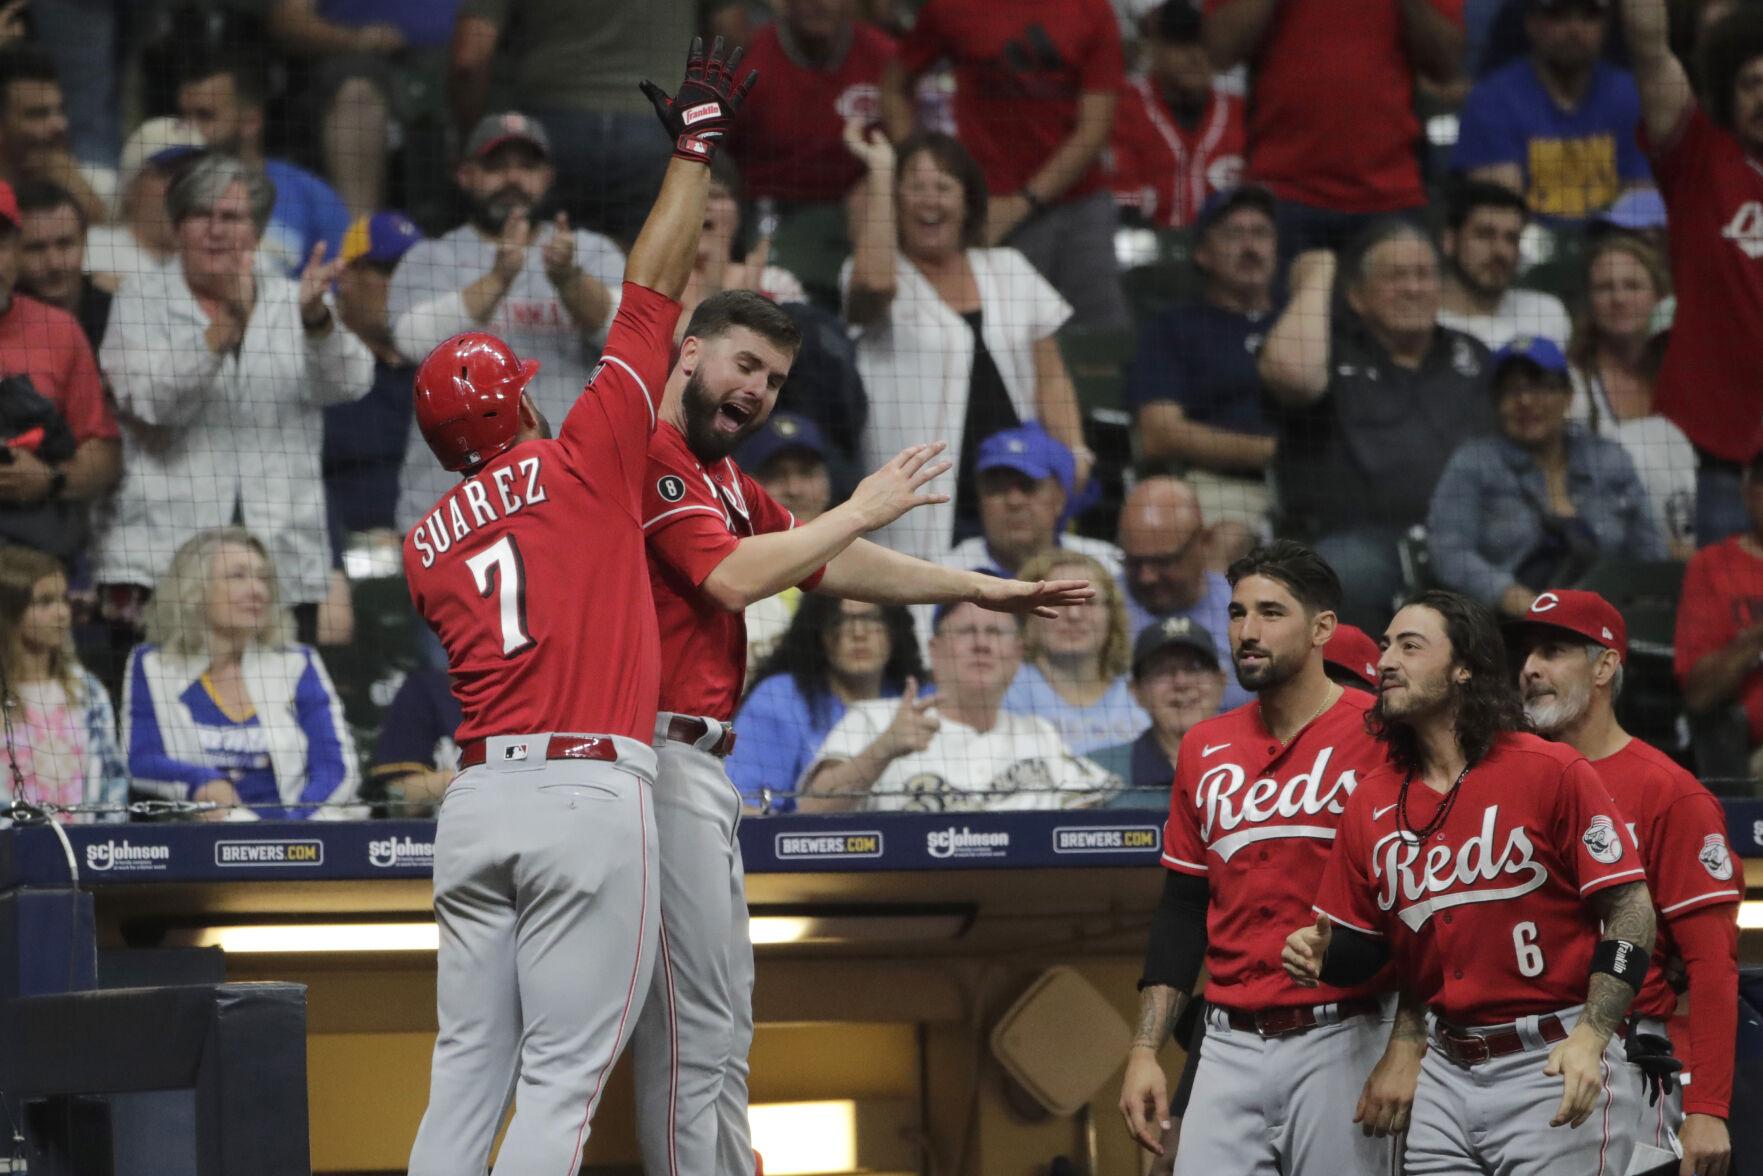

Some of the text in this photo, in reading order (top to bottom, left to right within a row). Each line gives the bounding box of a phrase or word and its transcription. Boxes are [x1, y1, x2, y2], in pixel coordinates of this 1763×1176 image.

[665, 479, 678, 497] 8
[413, 456, 549, 570] SUAREZ
[465, 532, 537, 660] 7
[1531, 592, 1560, 613] C
[1195, 746, 1359, 856] Reds
[222, 845, 317, 861] BREWERS.COM
[782, 837, 876, 854] BREWERS.COM
[1059, 831, 1154, 848] BREWERS.COM
[1372, 804, 1549, 925] Reds
[1512, 921, 1546, 979] 6
